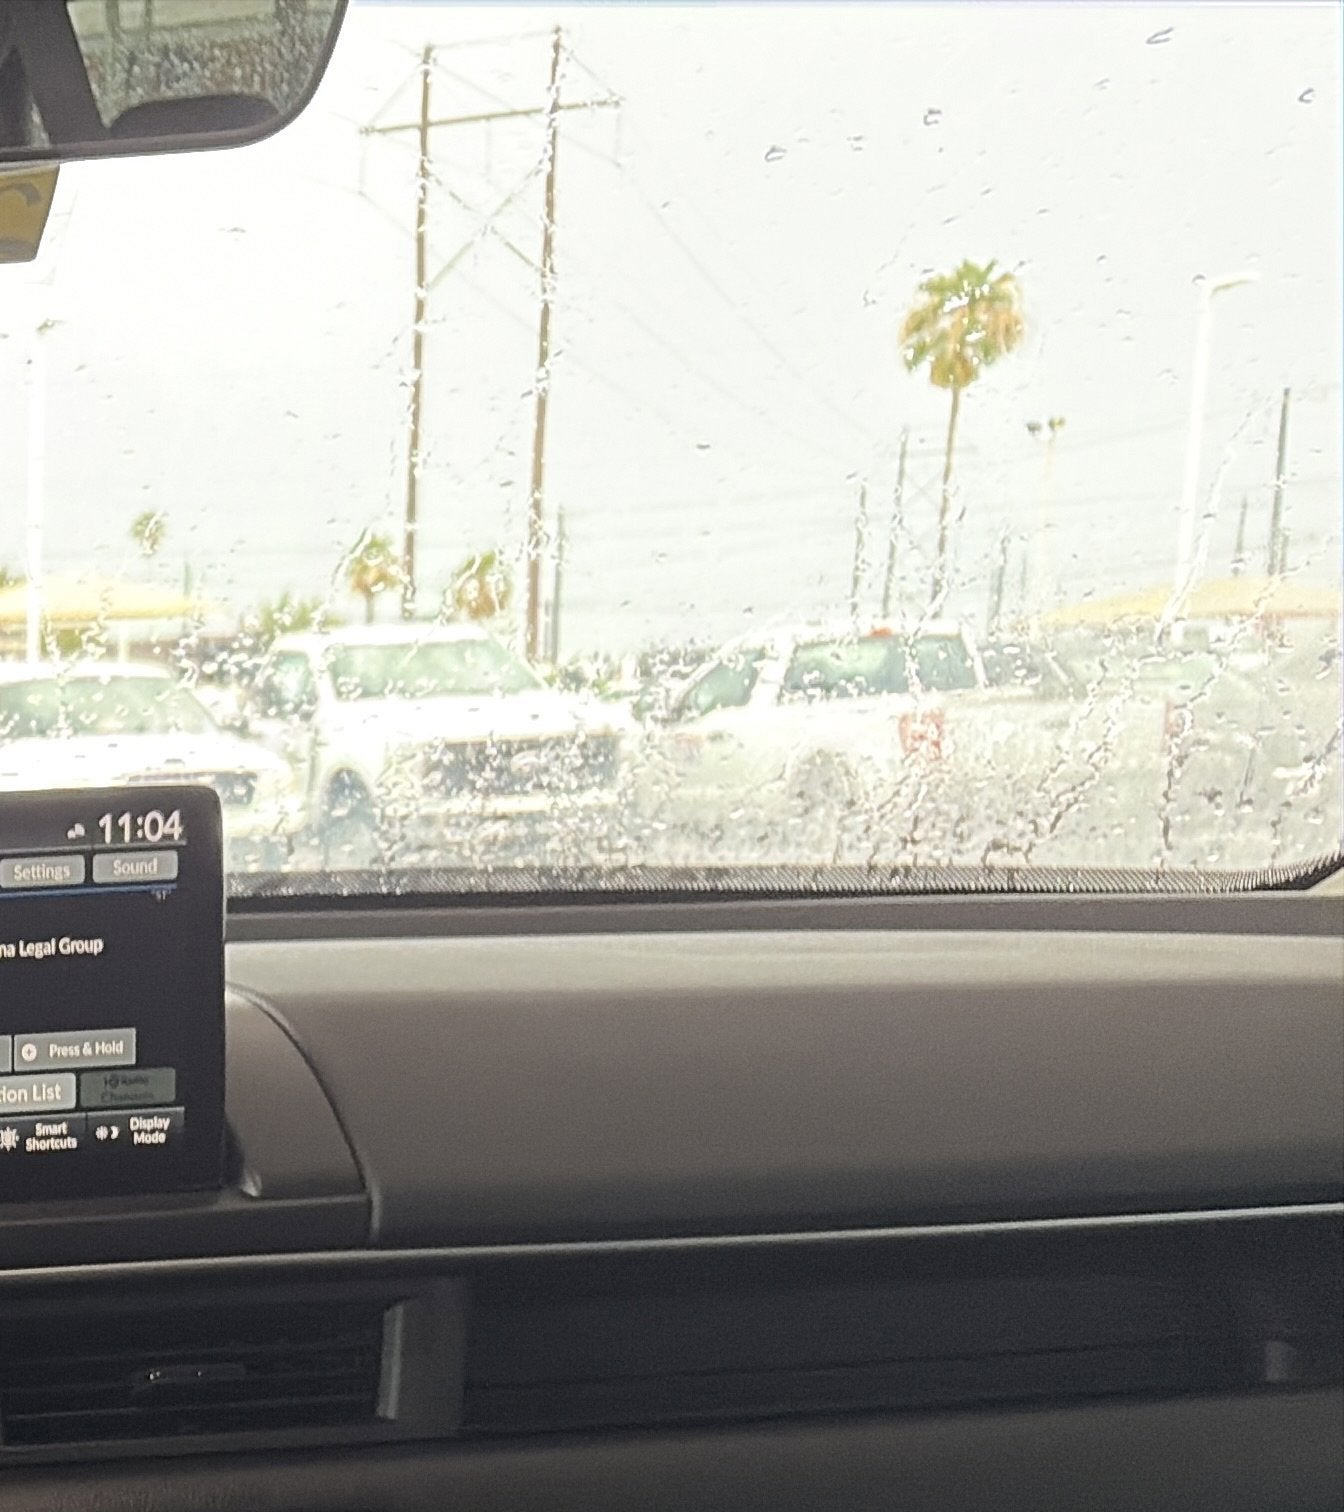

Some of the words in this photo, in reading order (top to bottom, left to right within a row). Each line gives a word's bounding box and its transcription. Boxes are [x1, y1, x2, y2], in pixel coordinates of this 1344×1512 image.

[98, 810, 183, 844] 11:04
[14, 863, 71, 881] Settings
[113, 857, 158, 875] Sound
[18, 938, 56, 959] Legal
[59, 936, 104, 957] Group
[49, 1043, 80, 1058] Press
[82, 1042, 92, 1056] &
[95, 1040, 124, 1056] Hold
[32, 1083, 62, 1101] List
[35, 1121, 68, 1136] Smart
[129, 1116, 170, 1132] Display
[25, 1136, 78, 1152] Shortcuts
[133, 1131, 166, 1145] Mode
